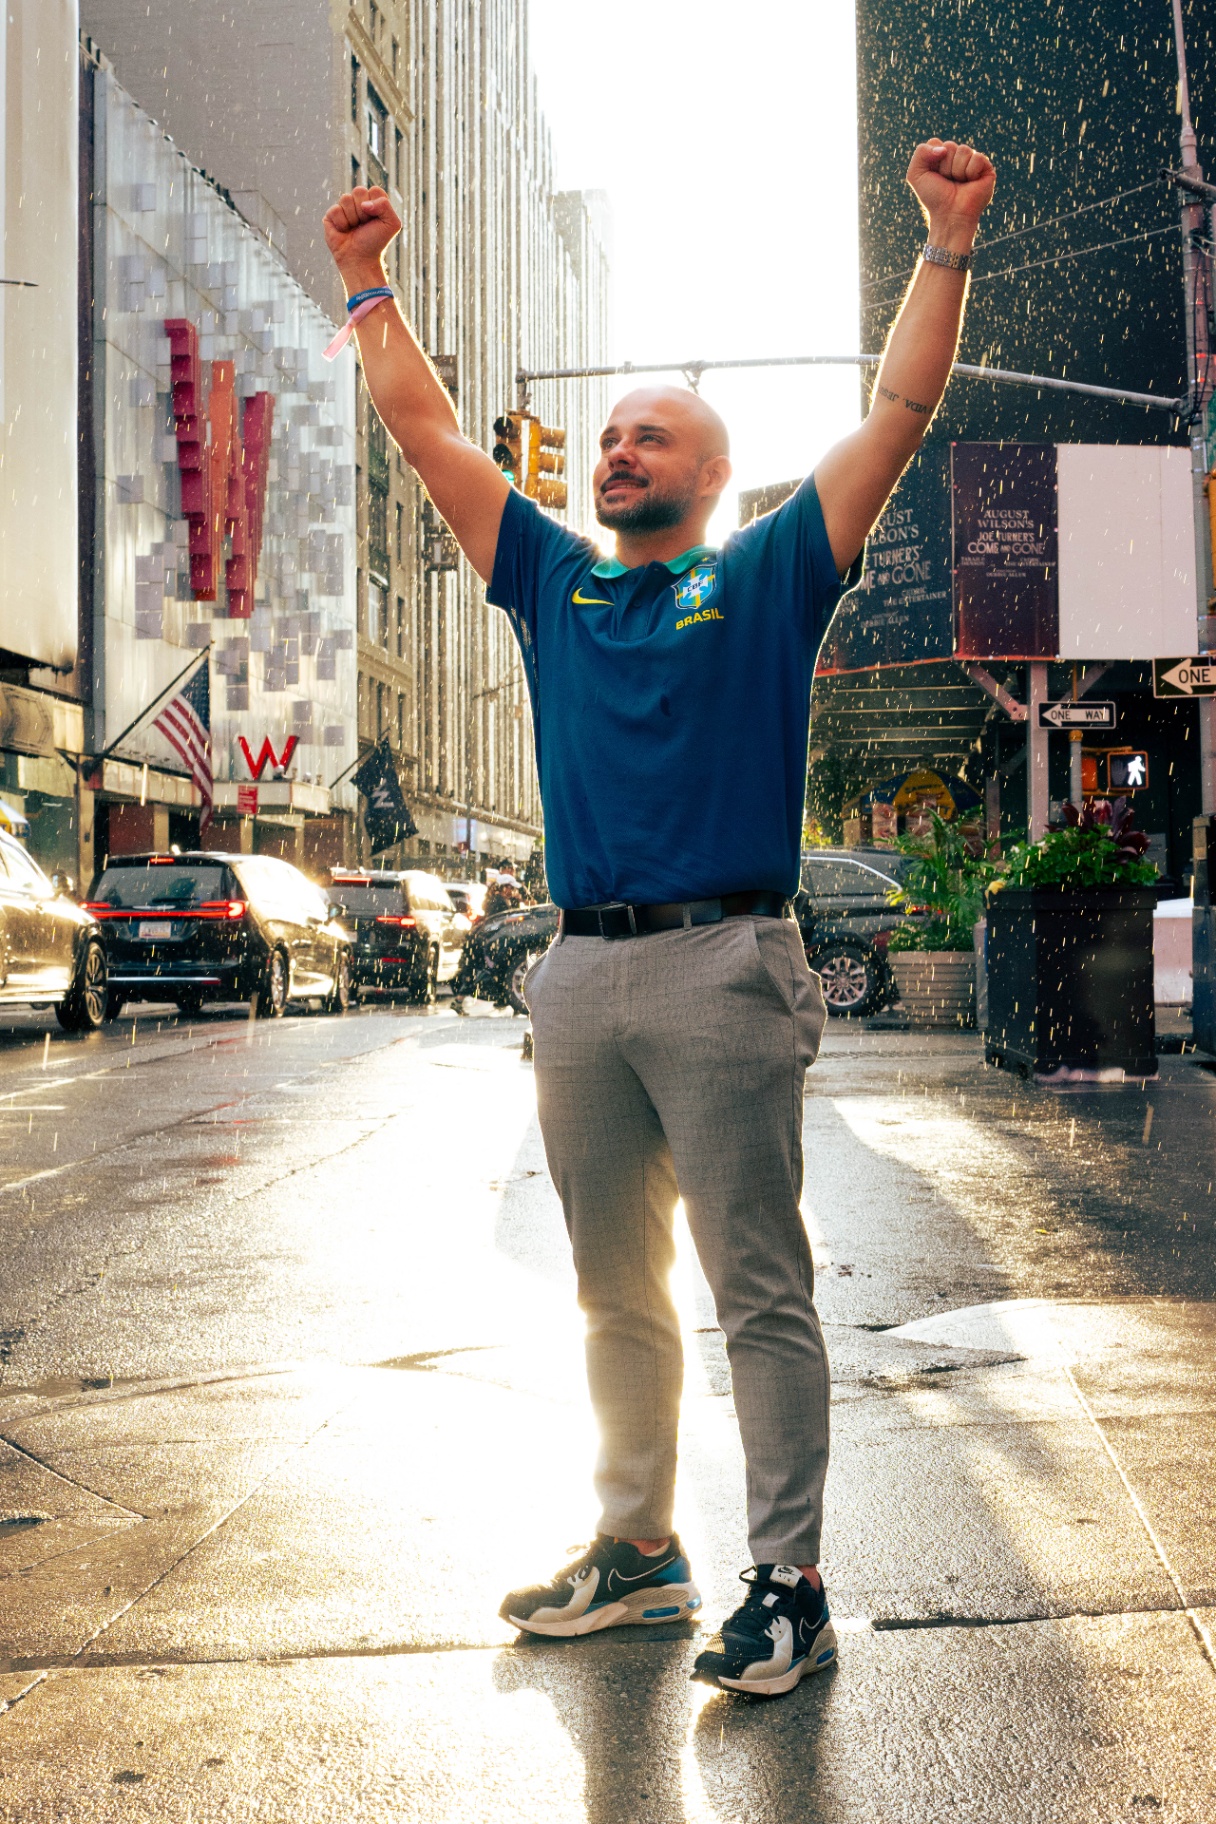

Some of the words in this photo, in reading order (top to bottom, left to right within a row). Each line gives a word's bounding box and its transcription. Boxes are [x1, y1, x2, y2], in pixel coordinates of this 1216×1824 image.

[879, 386, 899, 402] JES
[878, 509, 914, 527] GUST
[983, 509, 1030, 519] AUGUST
[977, 519, 1035, 529] WILSON'S
[868, 524, 919, 546] LSON'S
[978, 531, 995, 542] JOE
[967, 541, 999, 554] COME
[1000, 545, 1011, 553] AND
[1011, 542, 1044, 555] GONE
[861, 570, 876, 590] ME
[891, 561, 932, 585] GONE
[675, 608, 724, 630] BRASIL
[1178, 668, 1211, 684] ONE
[1051, 710, 1071, 720] ONE
[1085, 708, 1105, 720] WAY
[238, 736, 300, 781] W
